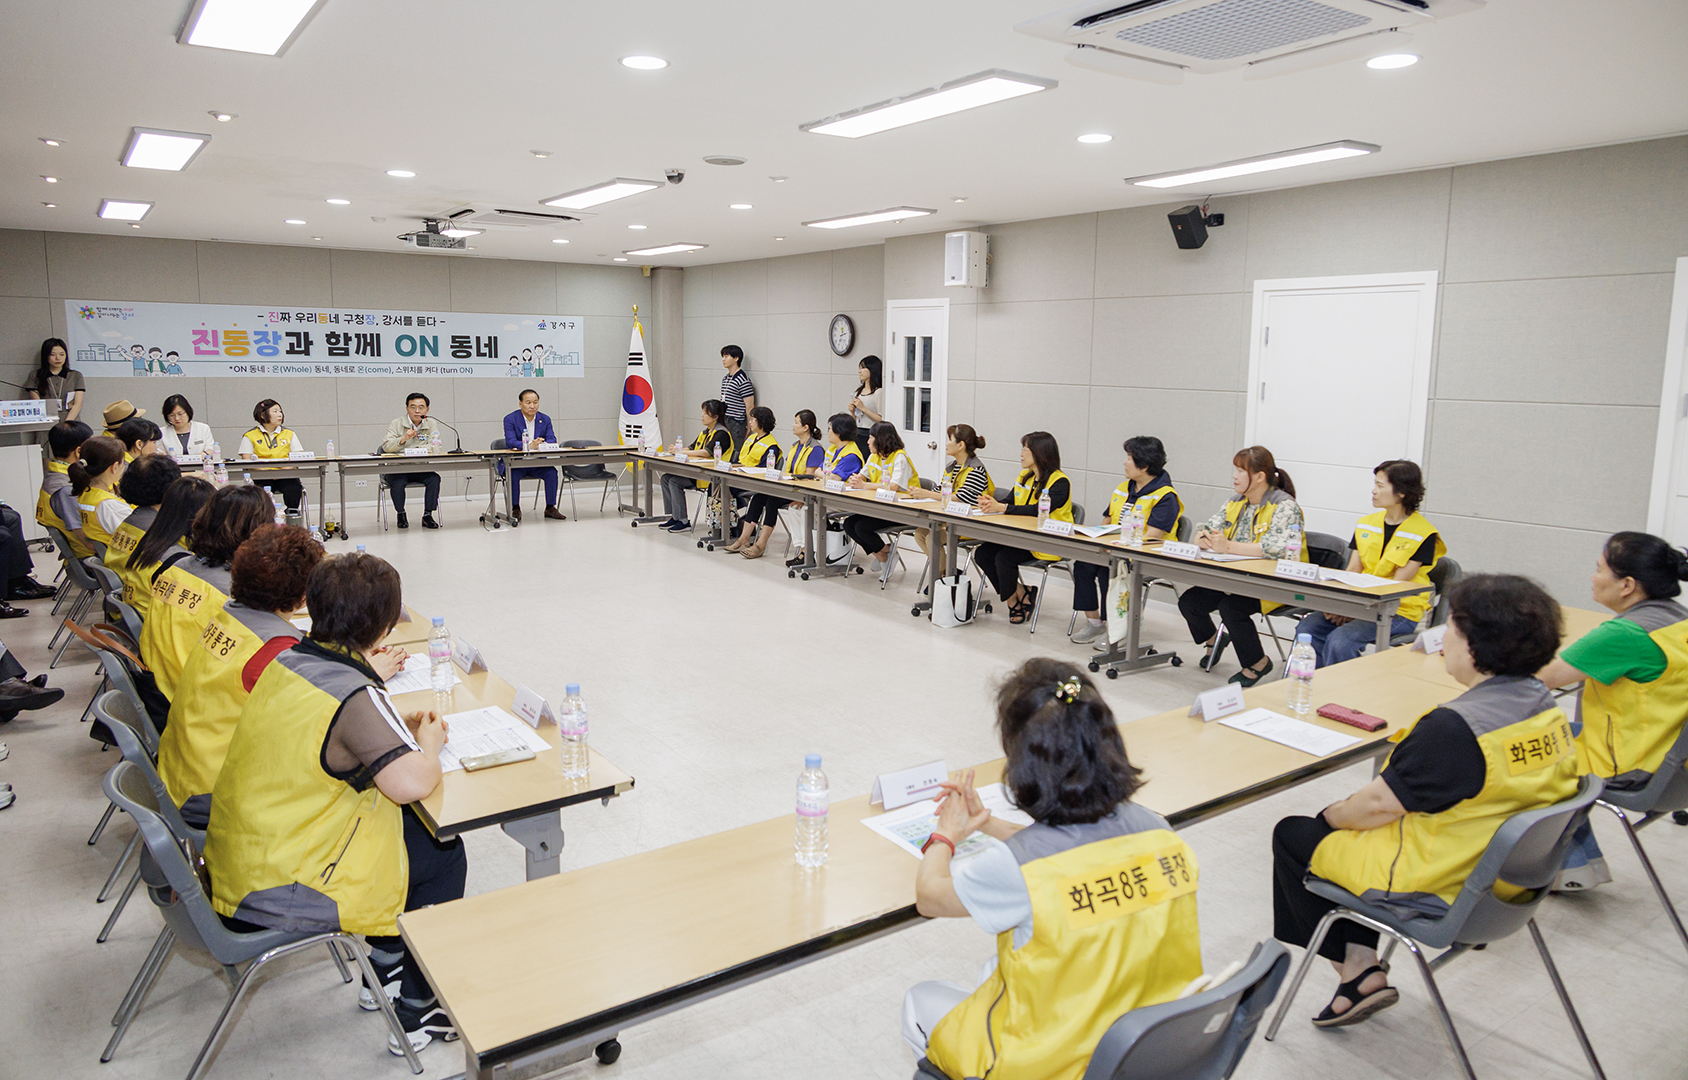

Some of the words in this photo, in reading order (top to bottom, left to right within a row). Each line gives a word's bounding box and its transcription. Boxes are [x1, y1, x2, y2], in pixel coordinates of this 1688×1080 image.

[268, 311, 291, 323] 진짜
[295, 312, 340, 325] 우리동네
[343, 313, 379, 326] 구청장,
[382, 314, 413, 327] 강서를
[416, 316, 437, 327] 듣다
[549, 321, 576, 330] 강서구
[190, 328, 314, 357] 진동장과
[325, 331, 382, 357] 함께
[394, 334, 439, 357] ON
[450, 335, 499, 359] 동네
[249, 365, 266, 374] 동네
[272, 365, 313, 375] 온(Whole)
[314, 366, 332, 375] 동네,
[333, 366, 356, 374] 동네로
[395, 366, 423, 375] 스위치를
[424, 366, 439, 375] 켜다
[440, 366, 458, 375] (turn
[459, 366, 474, 375] ON)
[178, 588, 202, 610] 통장
[210, 631, 237, 656] 통장
[1068, 866, 1149, 914] 화곡8동
[1158, 852, 1191, 888] 통장
